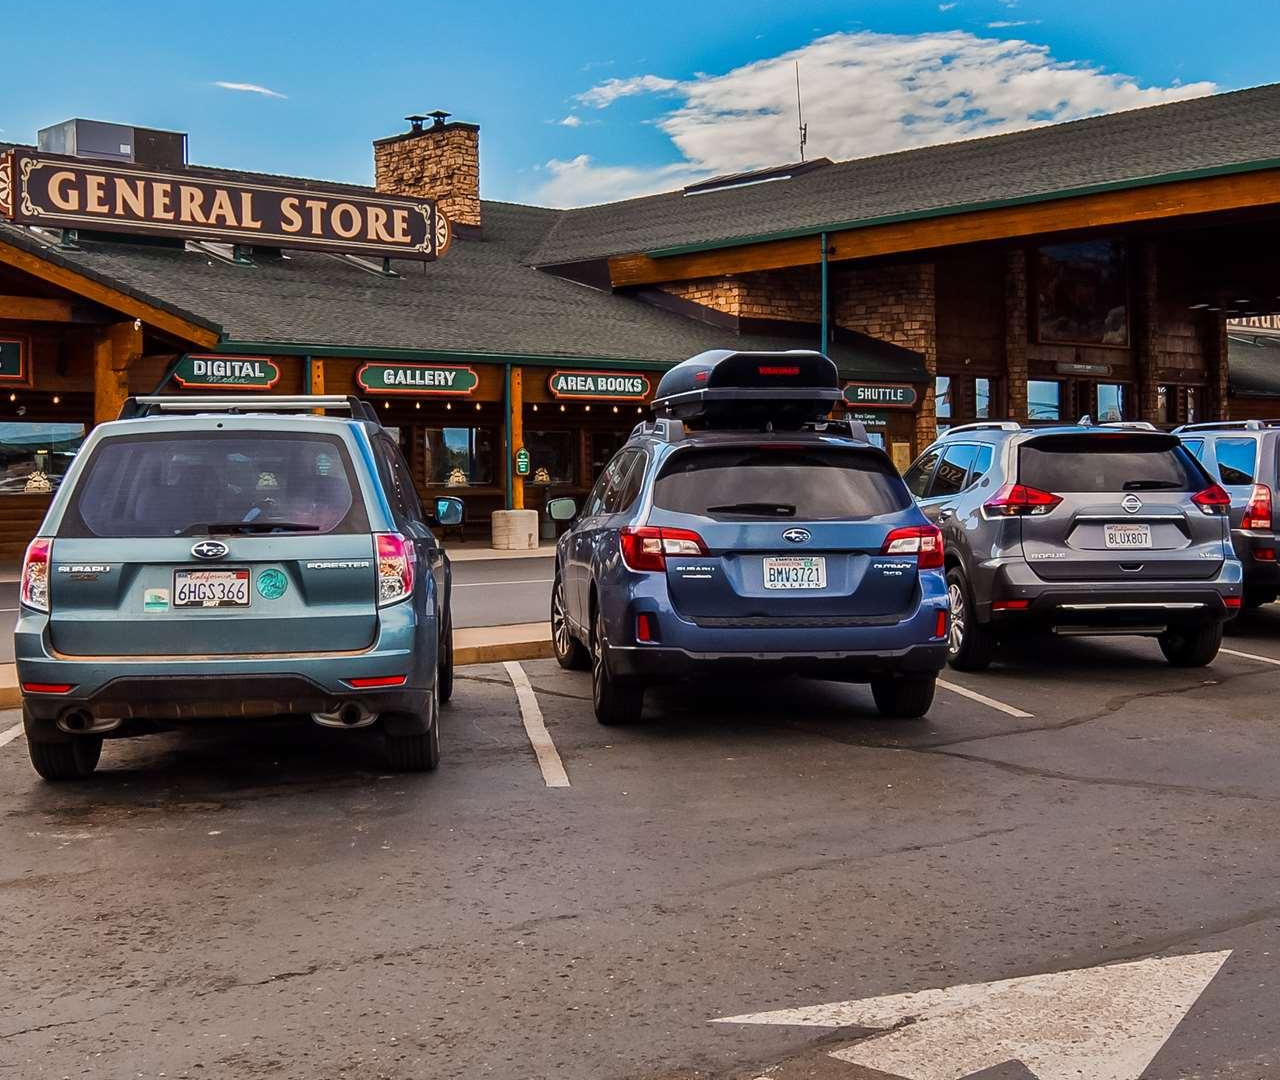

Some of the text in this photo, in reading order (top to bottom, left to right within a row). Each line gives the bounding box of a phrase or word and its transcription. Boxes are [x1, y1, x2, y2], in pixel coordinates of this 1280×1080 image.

[47, 171, 413, 244] GENERAL STORE
[193, 360, 265, 378] DIGITAL
[383, 369, 456, 386] GALLERY
[557, 376, 642, 392] AREA BOOKS
[857, 387, 904, 401] SHUTTLE
[1108, 532, 1149, 544] 8LUX807
[306, 561, 369, 569] FORESTER
[769, 568, 820, 582] BMV3721
[178, 582, 245, 601] 6HGS366
